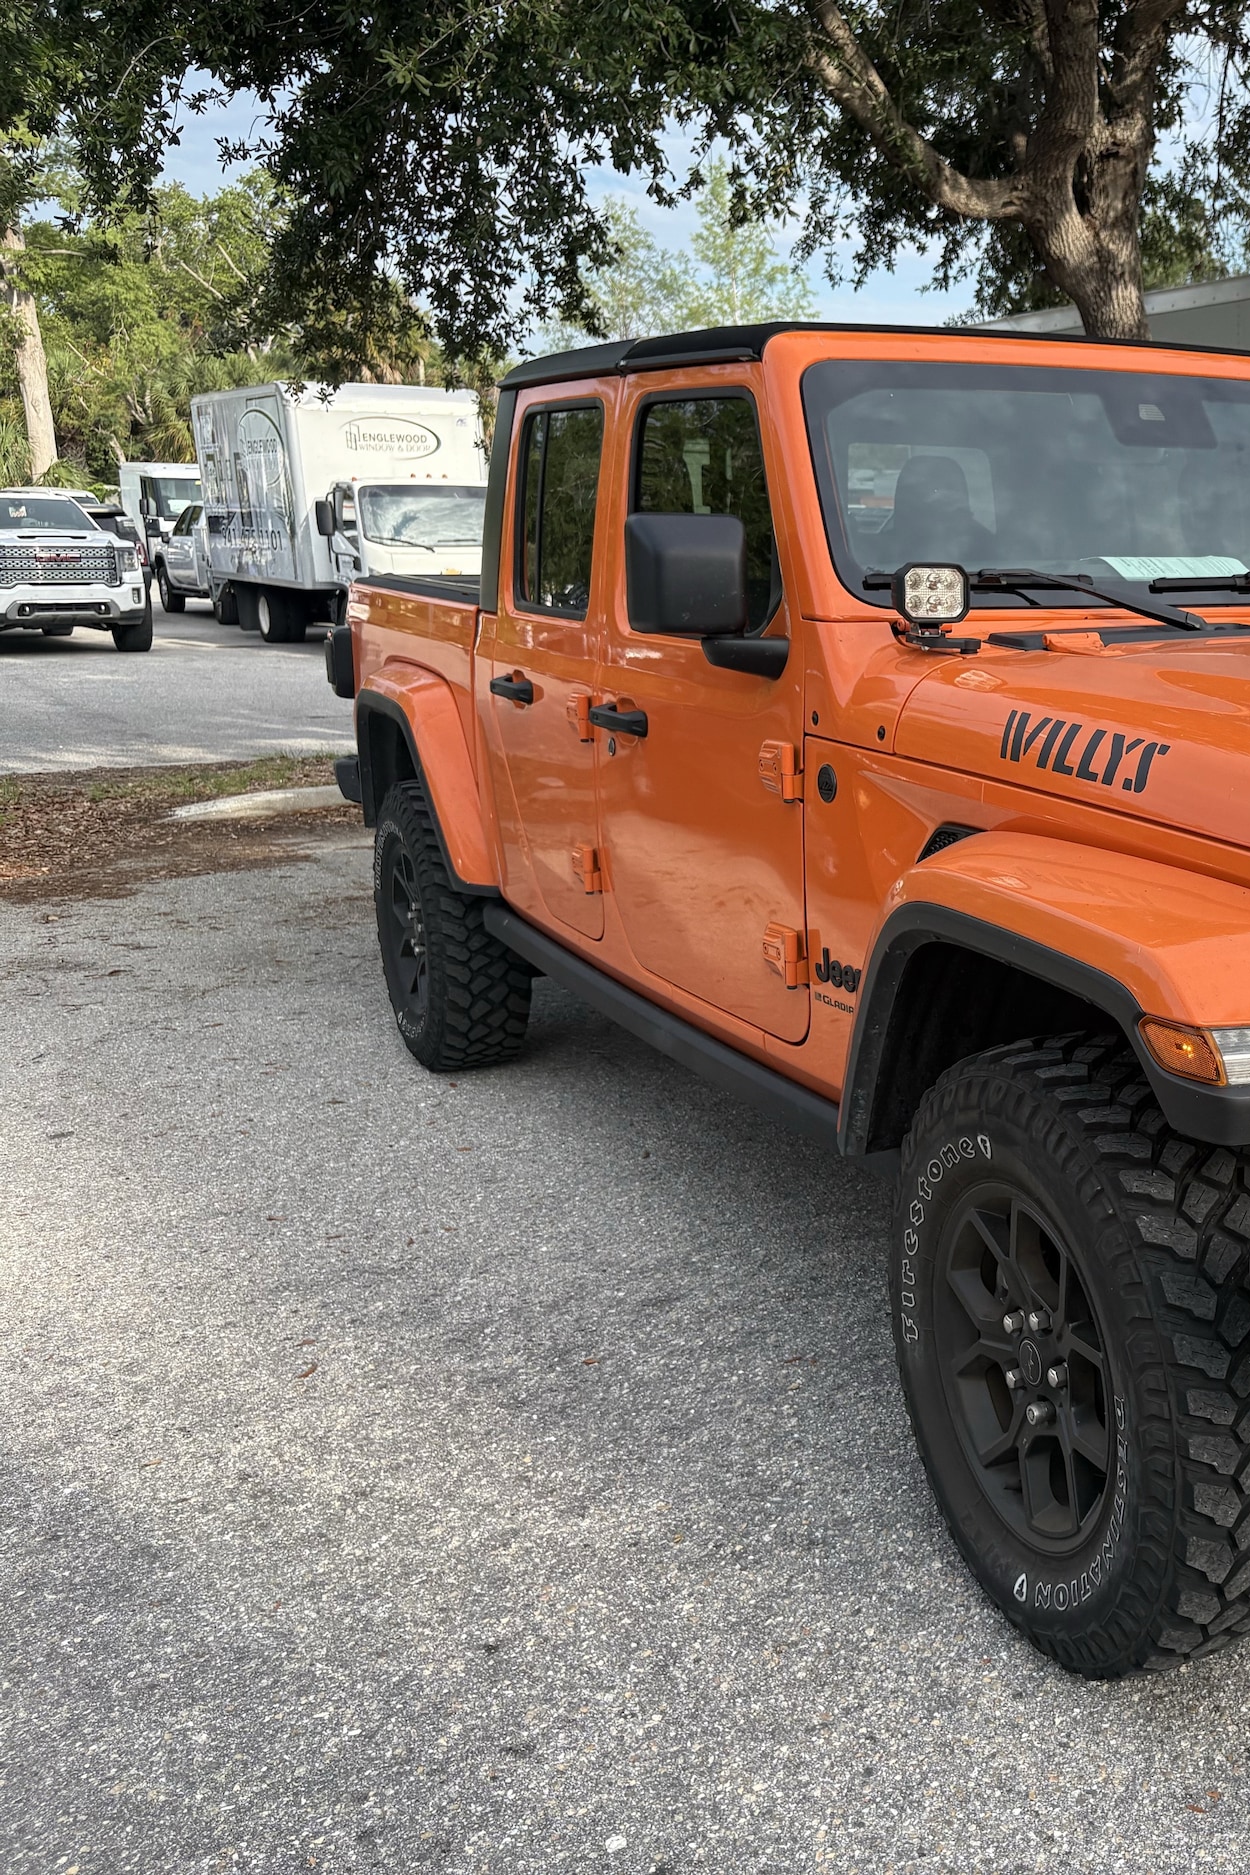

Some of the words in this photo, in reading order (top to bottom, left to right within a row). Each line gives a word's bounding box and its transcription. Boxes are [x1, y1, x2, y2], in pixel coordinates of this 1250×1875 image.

[362, 432, 428, 444] ENGLEWOOD
[1000, 709, 1172, 794] WILLYS
[1034, 1392, 1129, 1611] DESTINATION
